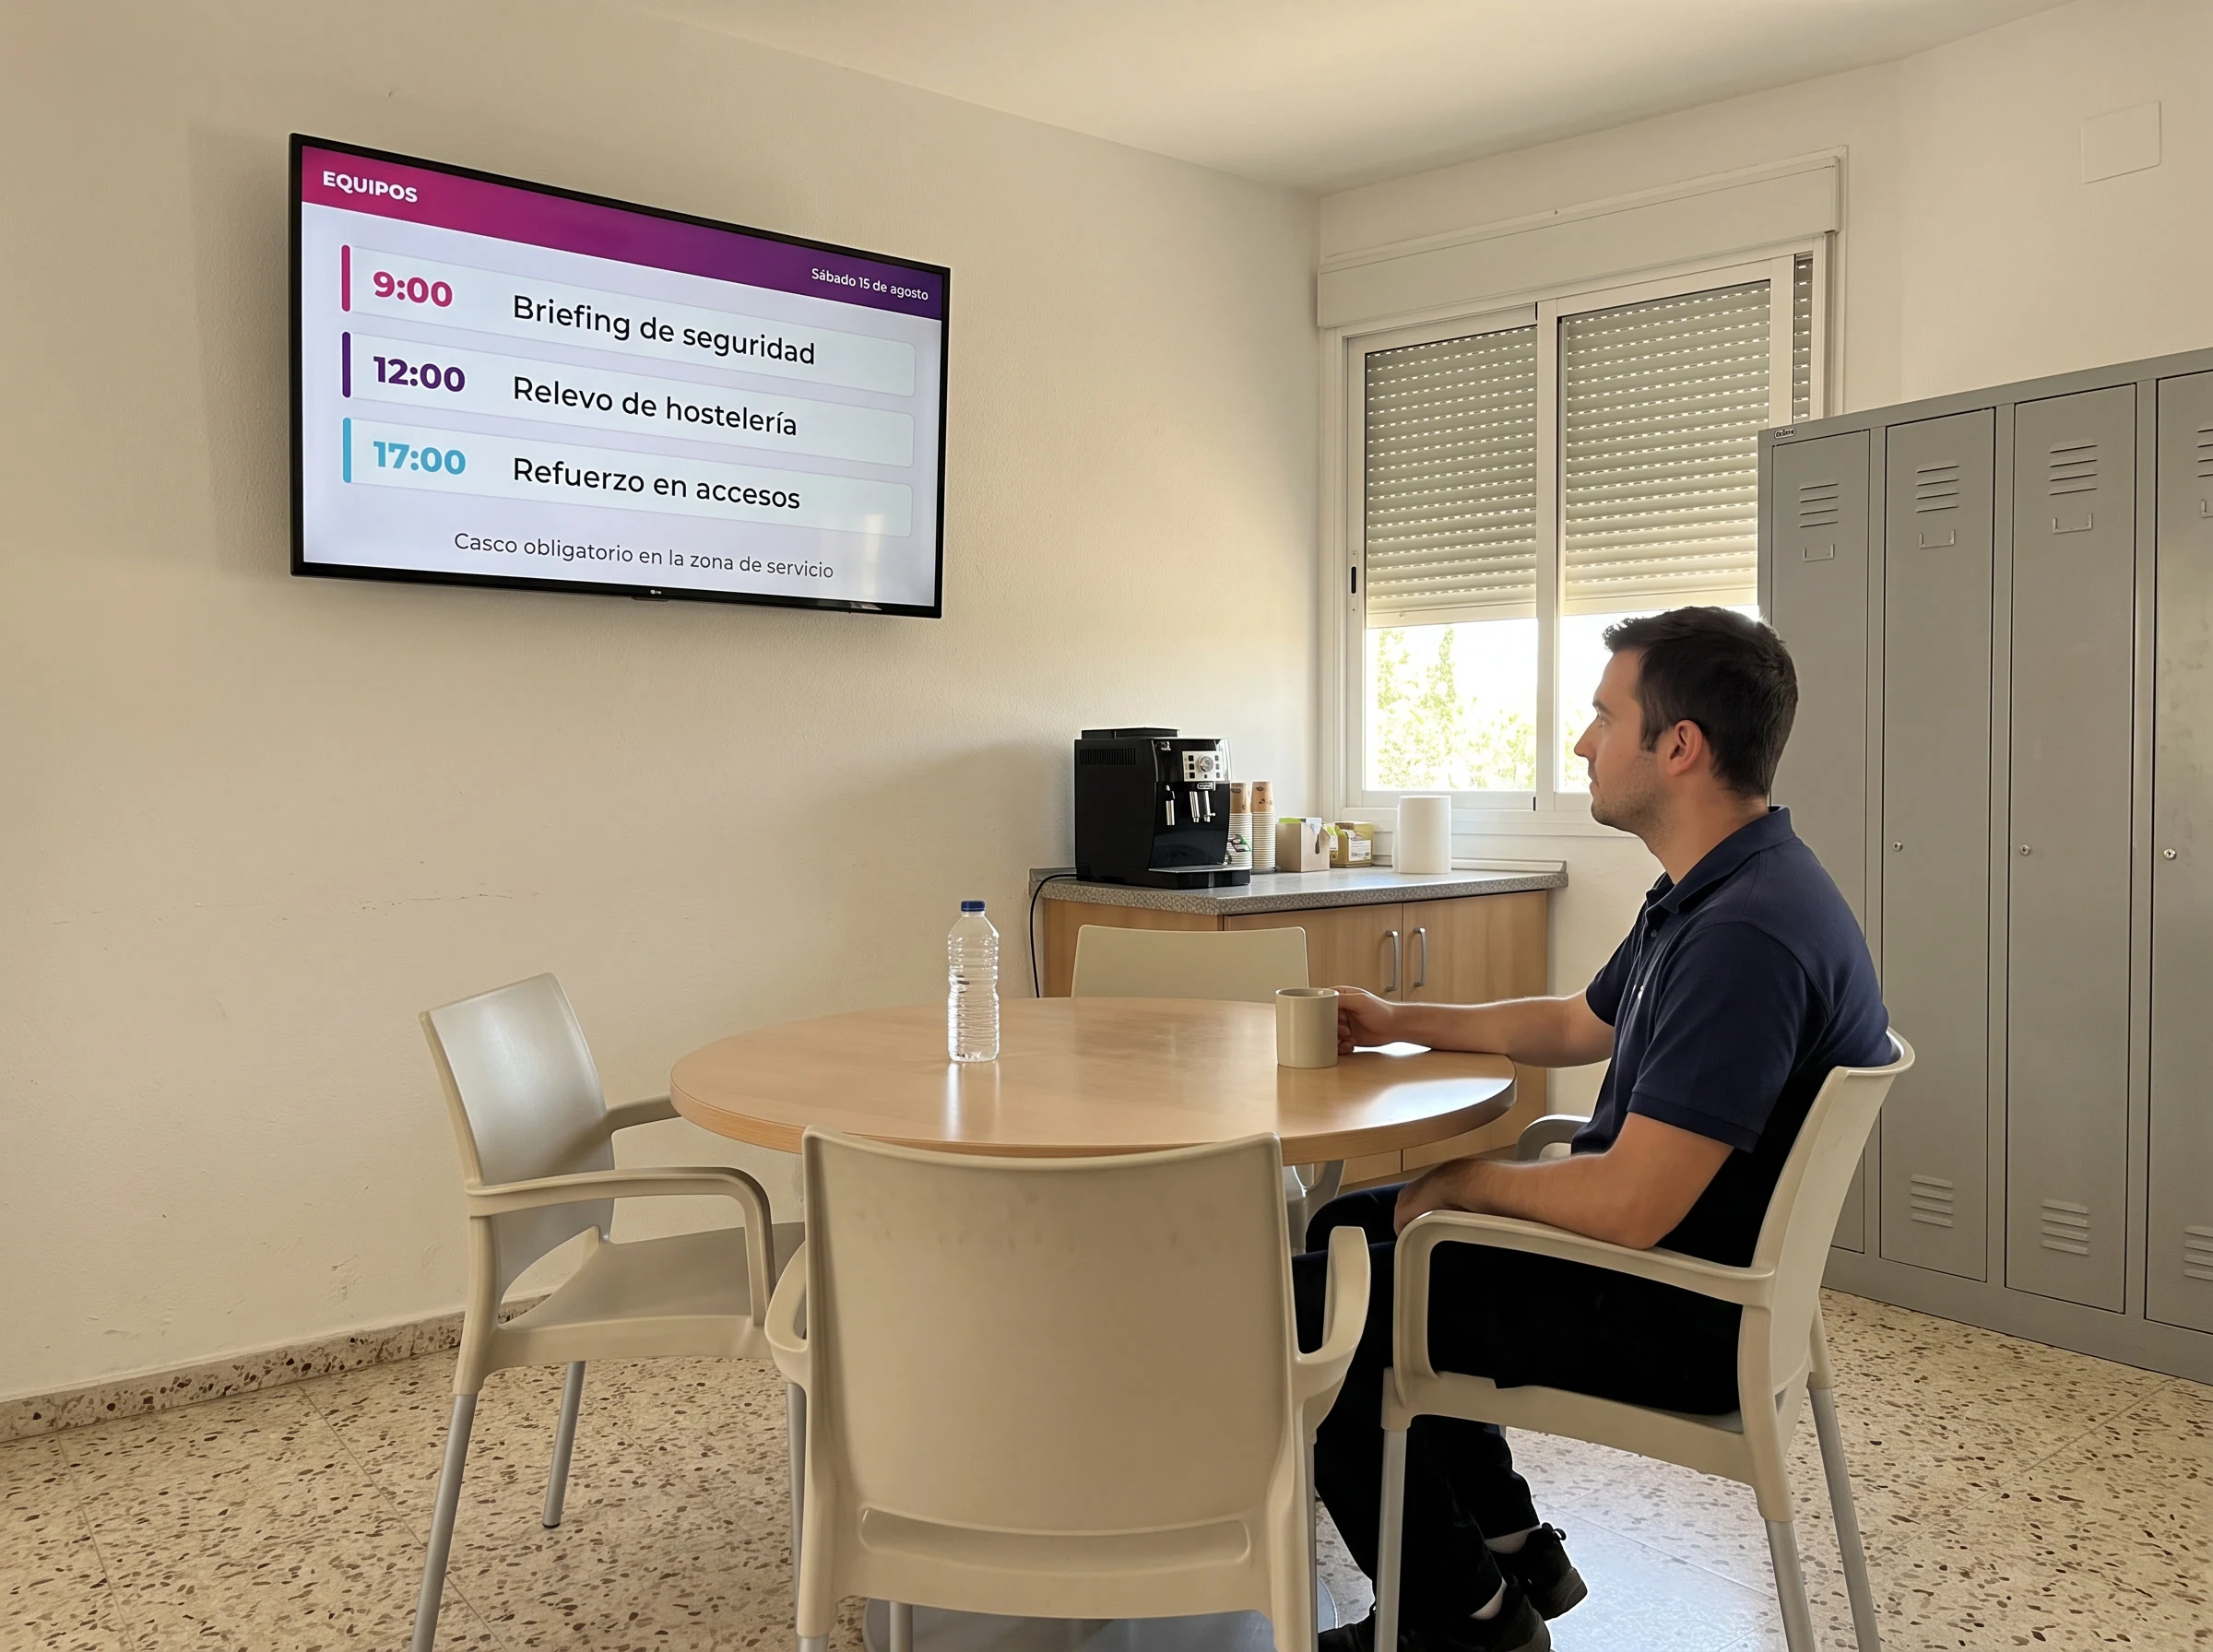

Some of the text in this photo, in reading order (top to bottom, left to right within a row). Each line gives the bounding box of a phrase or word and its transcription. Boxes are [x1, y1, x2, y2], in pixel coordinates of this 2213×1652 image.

[323, 170, 419, 203] EQUIPOS
[811, 267, 929, 301] Sábado 15 de agosto
[373, 271, 815, 365] 9:00 Briefing de seguridad
[373, 355, 797, 436] 12:00 Relevo de hostelería
[373, 440, 800, 510] 17:00 Refuerzo en accesos
[454, 532, 834, 579] Casco obligatorio en la zona de servicio
